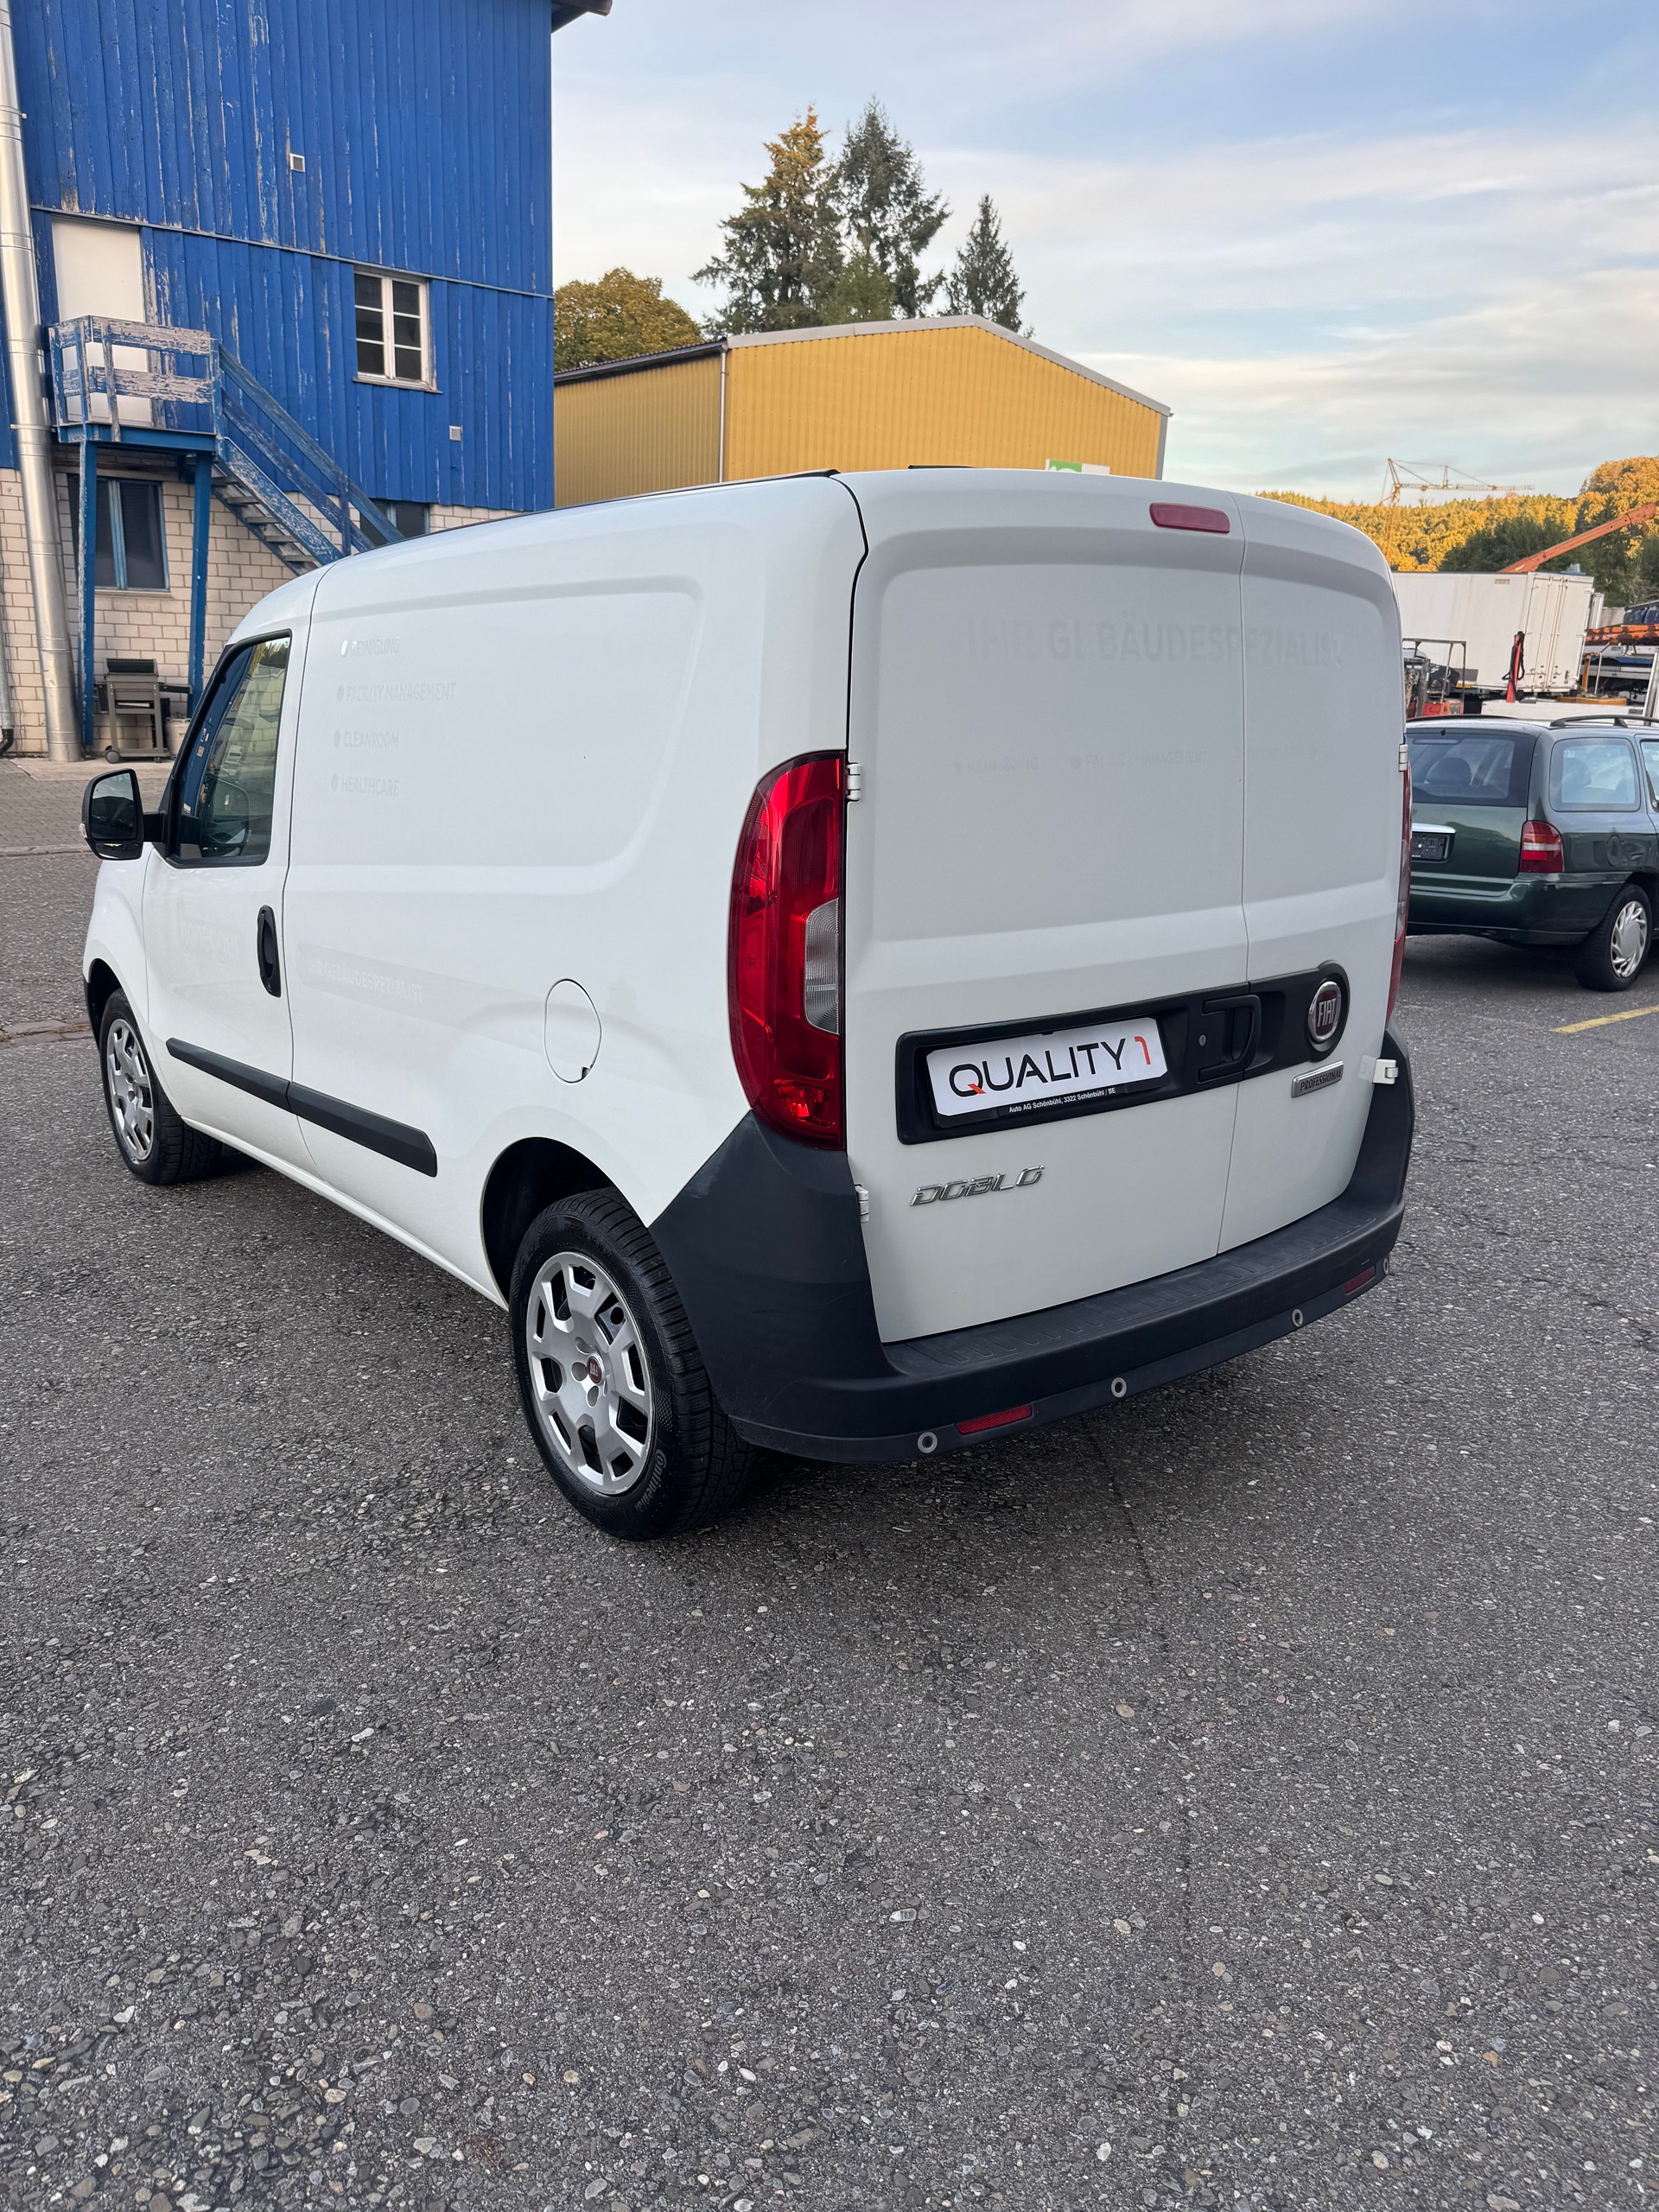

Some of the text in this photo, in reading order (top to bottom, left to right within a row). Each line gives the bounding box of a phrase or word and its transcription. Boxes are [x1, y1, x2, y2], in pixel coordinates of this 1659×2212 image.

[350, 636, 401, 658] REINIGUNG
[346, 681, 457, 702] FACILITY MANAGEMENT
[343, 730, 400, 748] CLEANROOM
[341, 776, 400, 797] HEALTHCARE
[1316, 997, 1337, 1028] FIAT
[949, 1036, 1151, 1097] QUALITY 1
[1300, 1067, 1342, 1092] PROFESSIONAL
[1064, 1095, 1077, 1103] 3322
[1077, 1089, 1105, 1101] Schönbühl
[1108, 1086, 1116, 1095] BE
[633, 1447, 668, 1514] Continental
